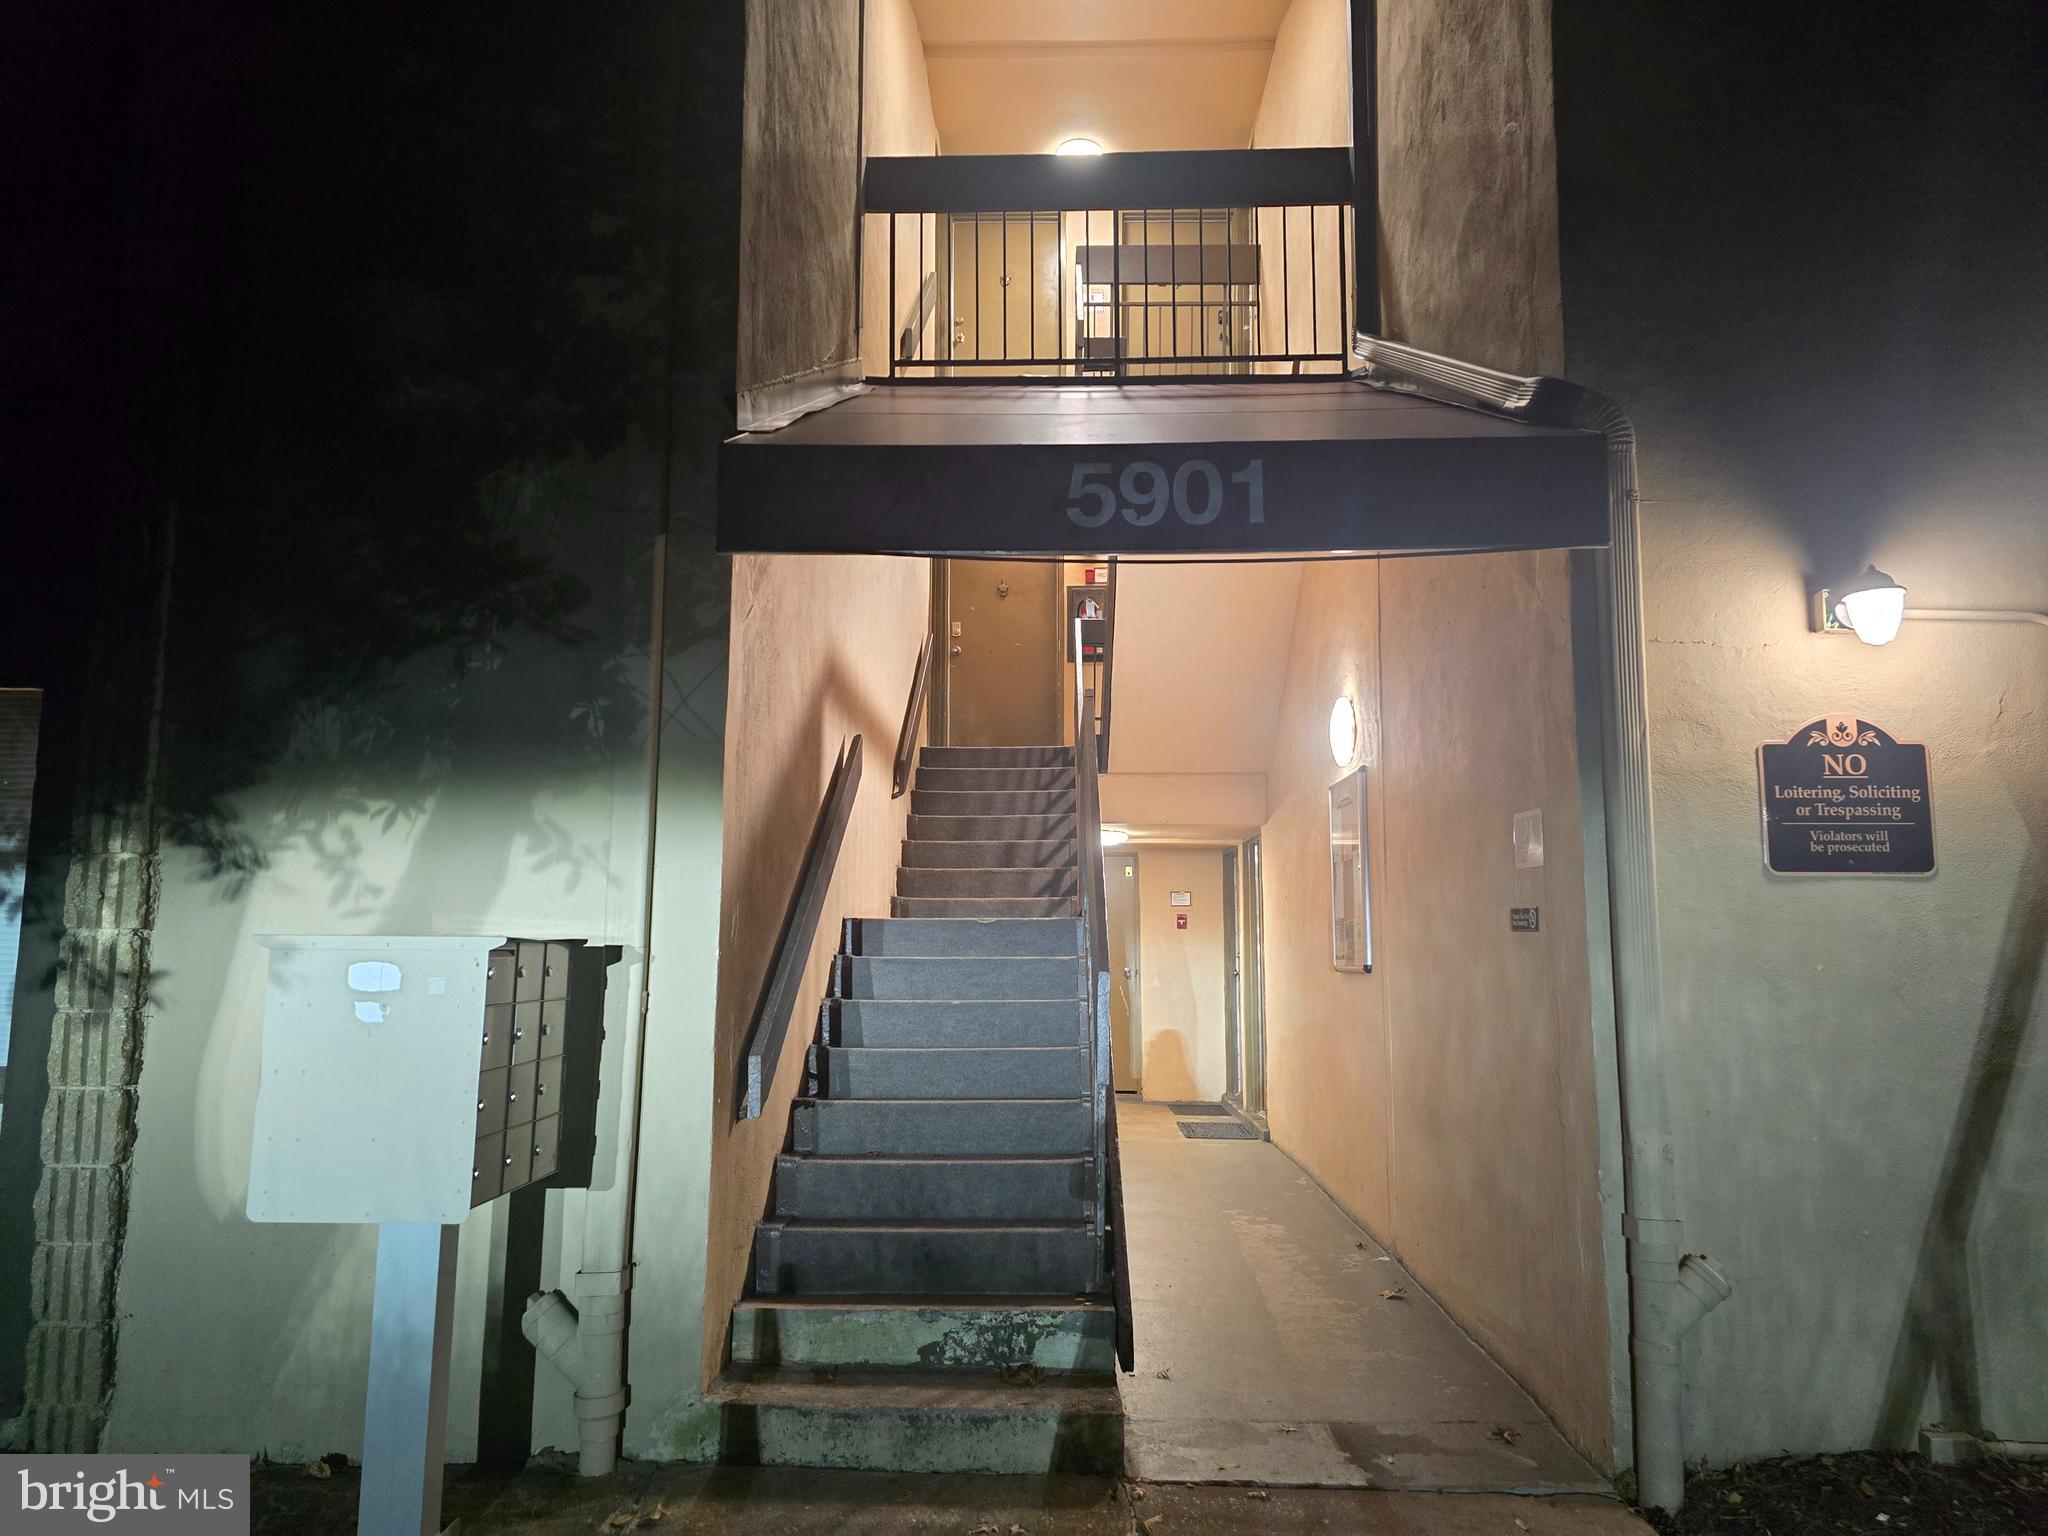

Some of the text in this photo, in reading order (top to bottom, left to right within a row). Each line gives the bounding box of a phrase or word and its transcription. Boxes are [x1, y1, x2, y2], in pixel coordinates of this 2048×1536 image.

[1066, 459, 1264, 528] 5901
[1822, 753, 1868, 776] NO
[1774, 785, 1921, 802] Loitering, Soliciting
[1796, 803, 1902, 820] or Trespassing
[1810, 830, 1889, 842] Violators will
[1810, 841, 1890, 855] be prosecuted
